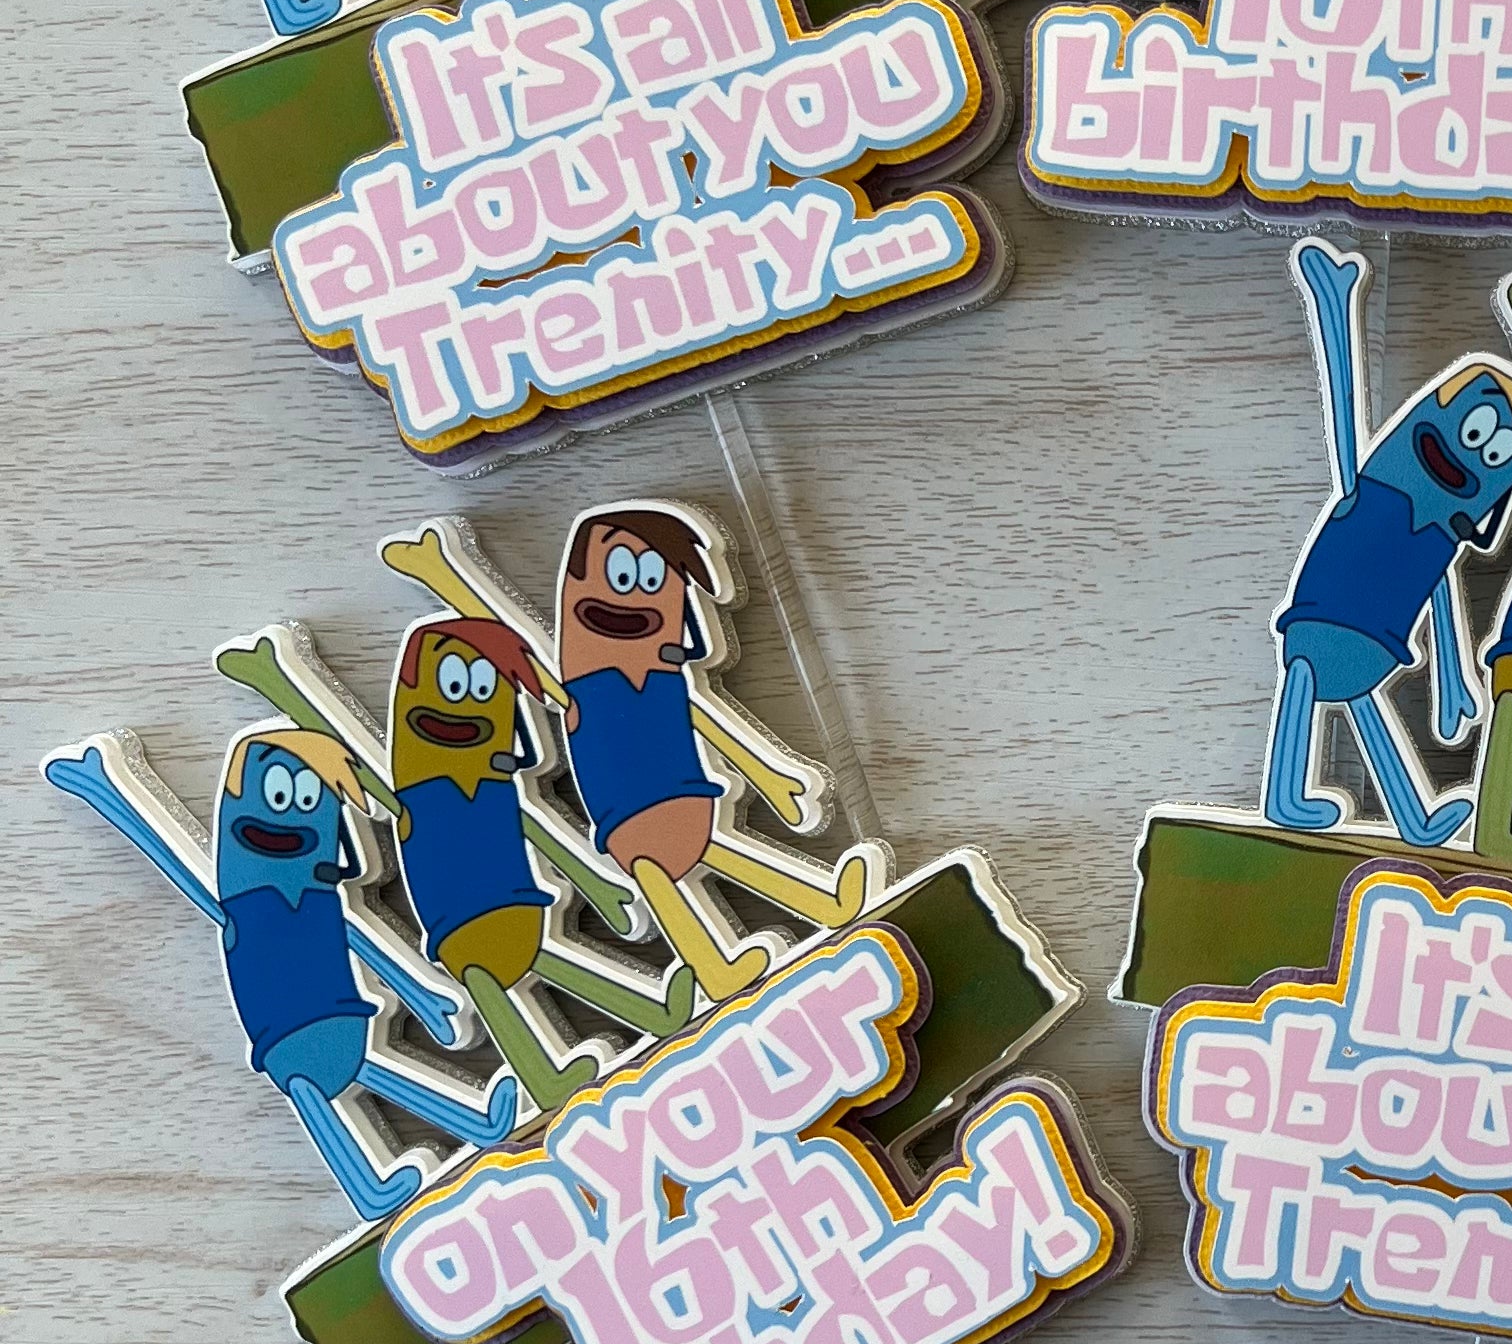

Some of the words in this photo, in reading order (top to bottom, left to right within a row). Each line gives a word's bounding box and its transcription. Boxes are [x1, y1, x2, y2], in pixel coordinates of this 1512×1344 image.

[299, 112, 673, 312] about
[681, 29, 940, 192] you
[401, 12, 602, 160] It's
[374, 204, 936, 415] Trenity...
[572, 965, 881, 1222] your
